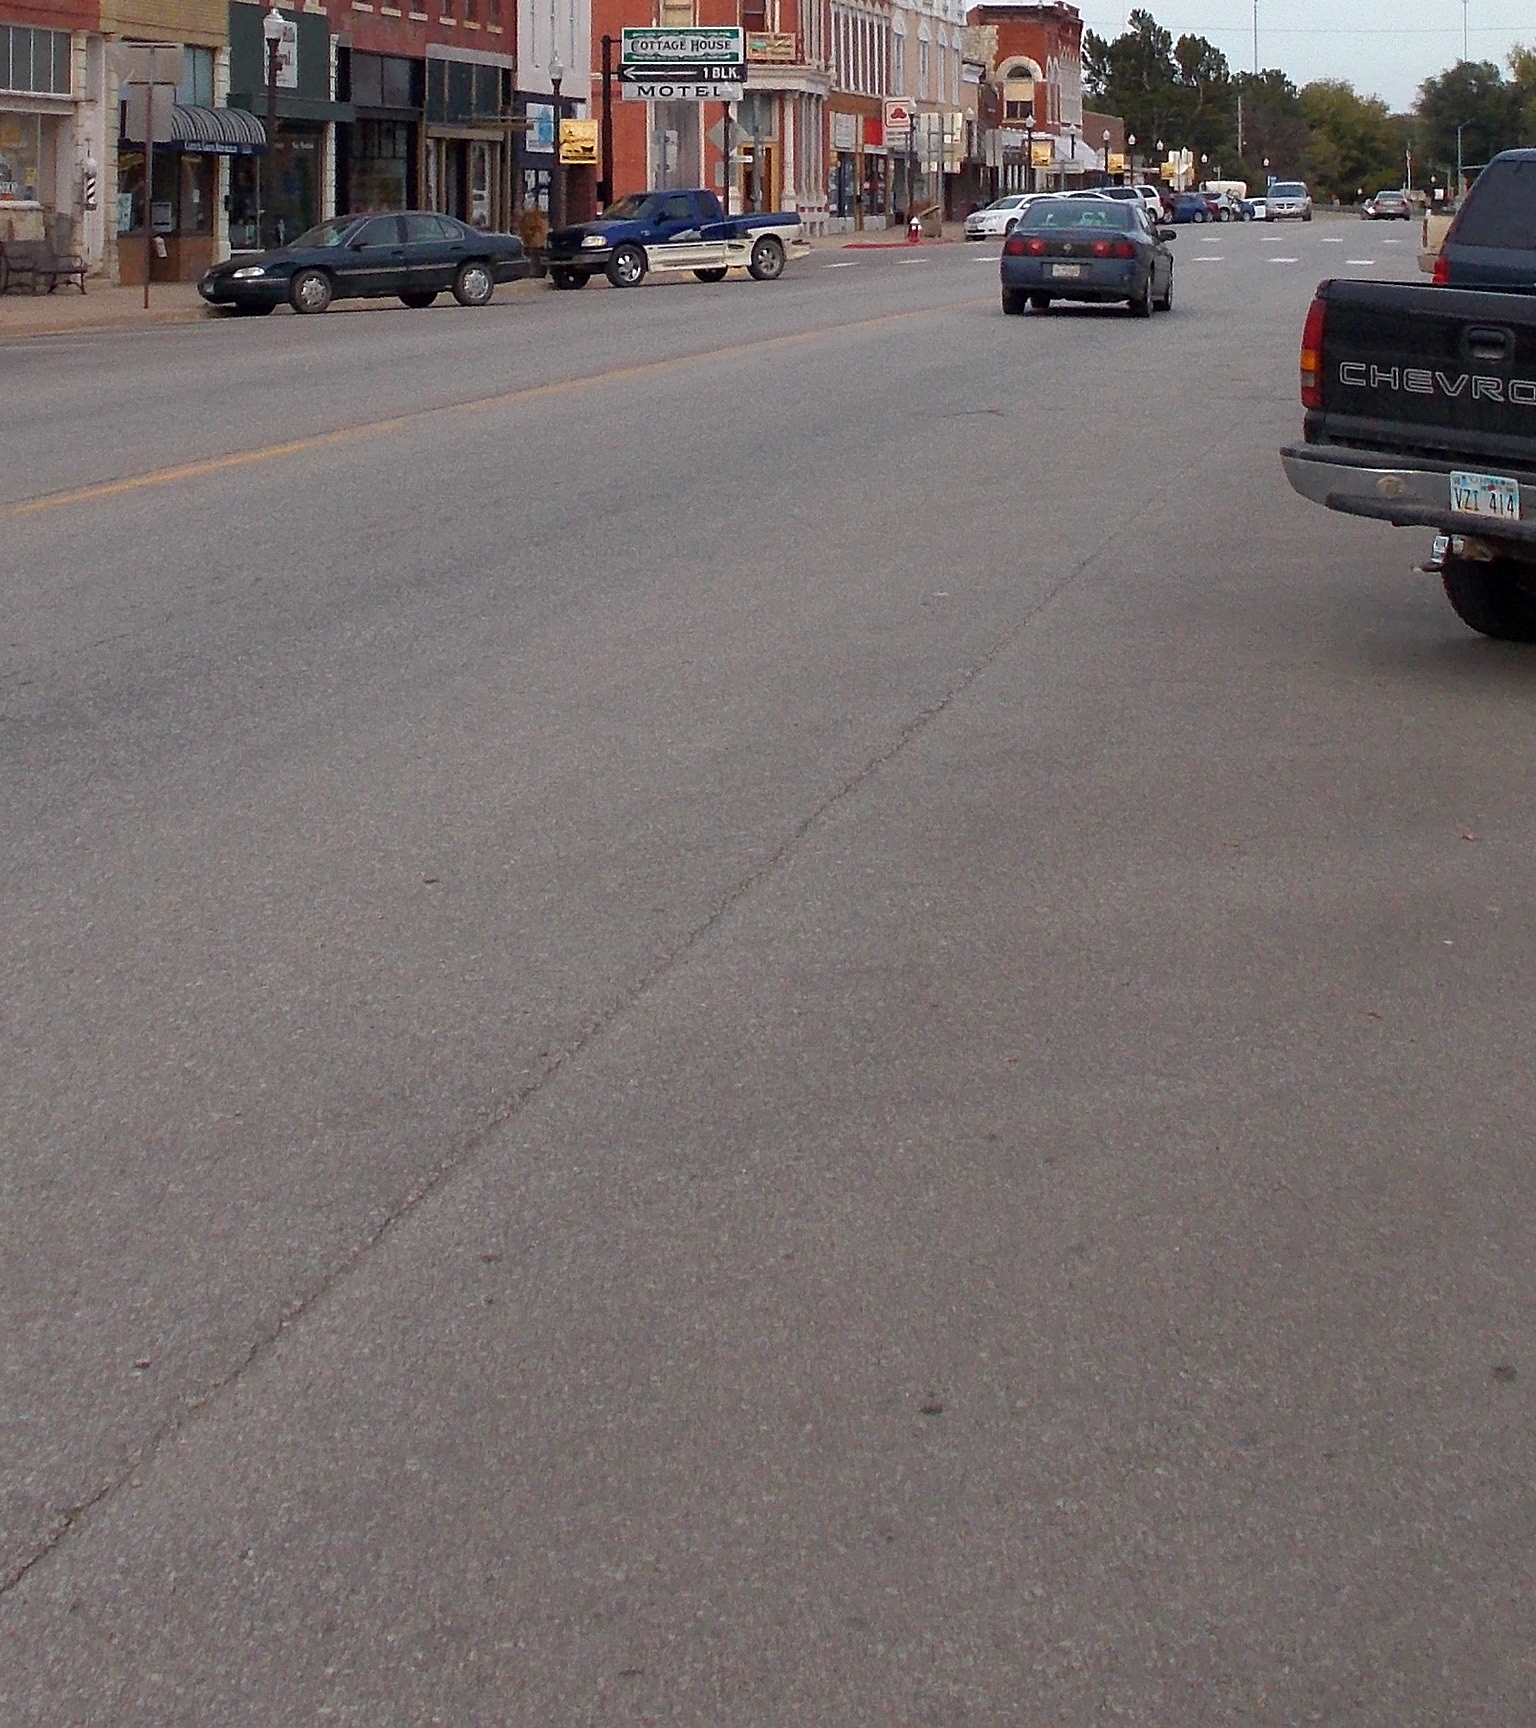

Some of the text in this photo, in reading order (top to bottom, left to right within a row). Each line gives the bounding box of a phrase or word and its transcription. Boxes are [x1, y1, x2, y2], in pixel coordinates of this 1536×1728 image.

[630, 39, 687, 53] COTTAGE
[690, 39, 732, 52] HOUSE
[703, 67, 741, 79] 1 BLK.
[637, 85, 721, 97] MOTEL
[1489, 492, 1515, 517] 414
